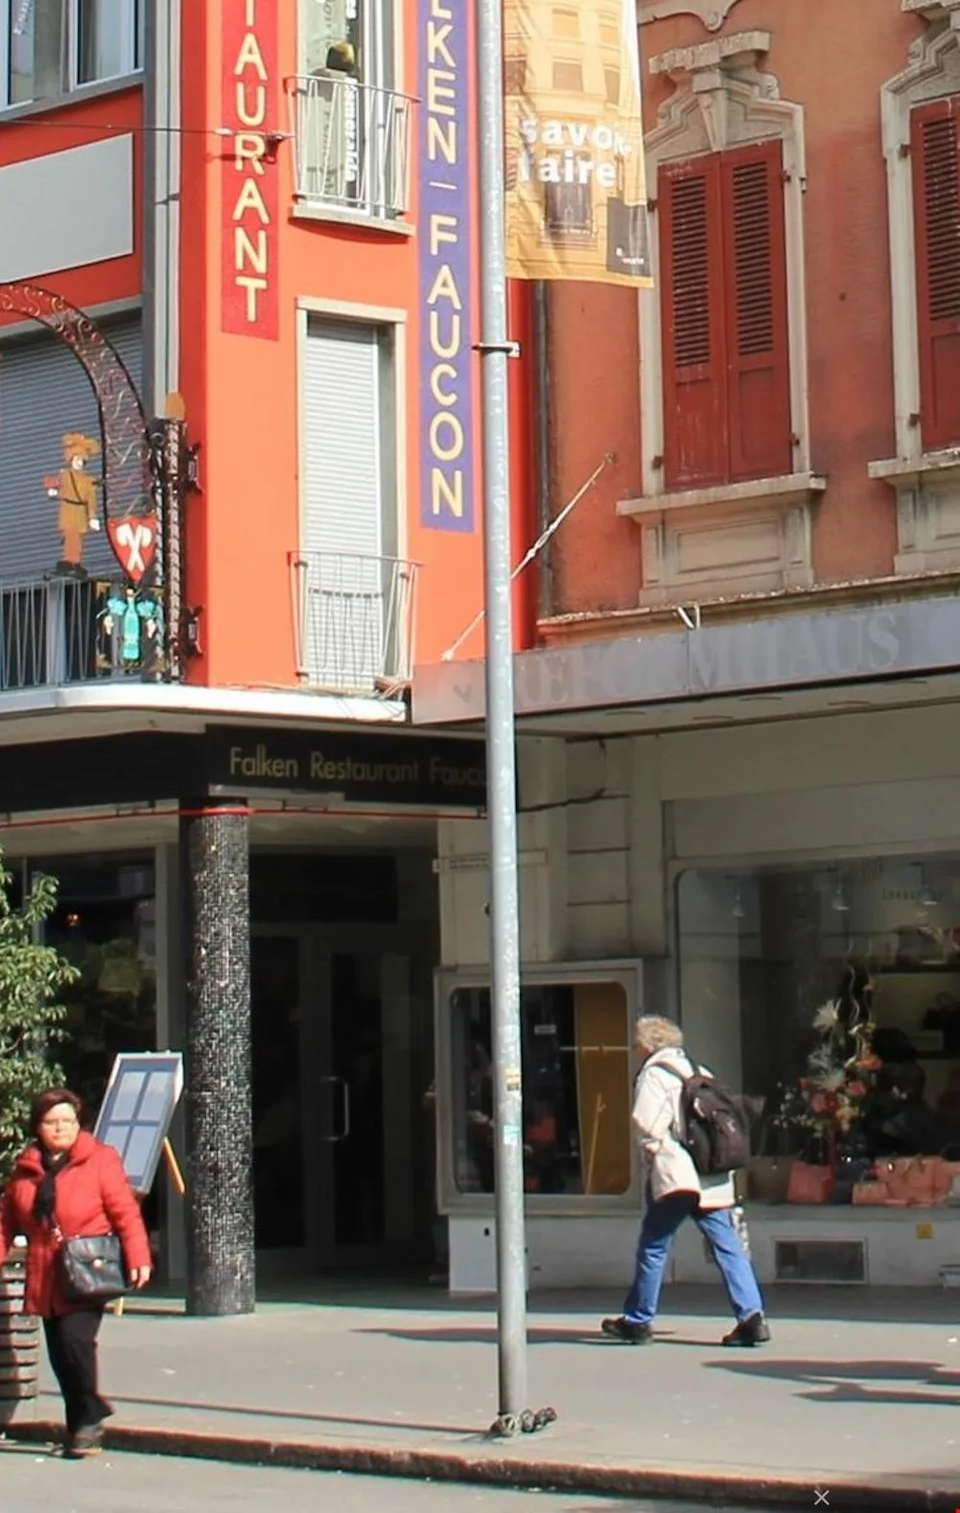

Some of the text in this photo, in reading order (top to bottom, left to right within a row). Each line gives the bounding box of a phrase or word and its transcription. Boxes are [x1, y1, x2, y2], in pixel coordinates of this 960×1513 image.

[428, 213, 463, 518] FAUCON
[230, 745, 487, 786] Falken Restaurant Fauc
